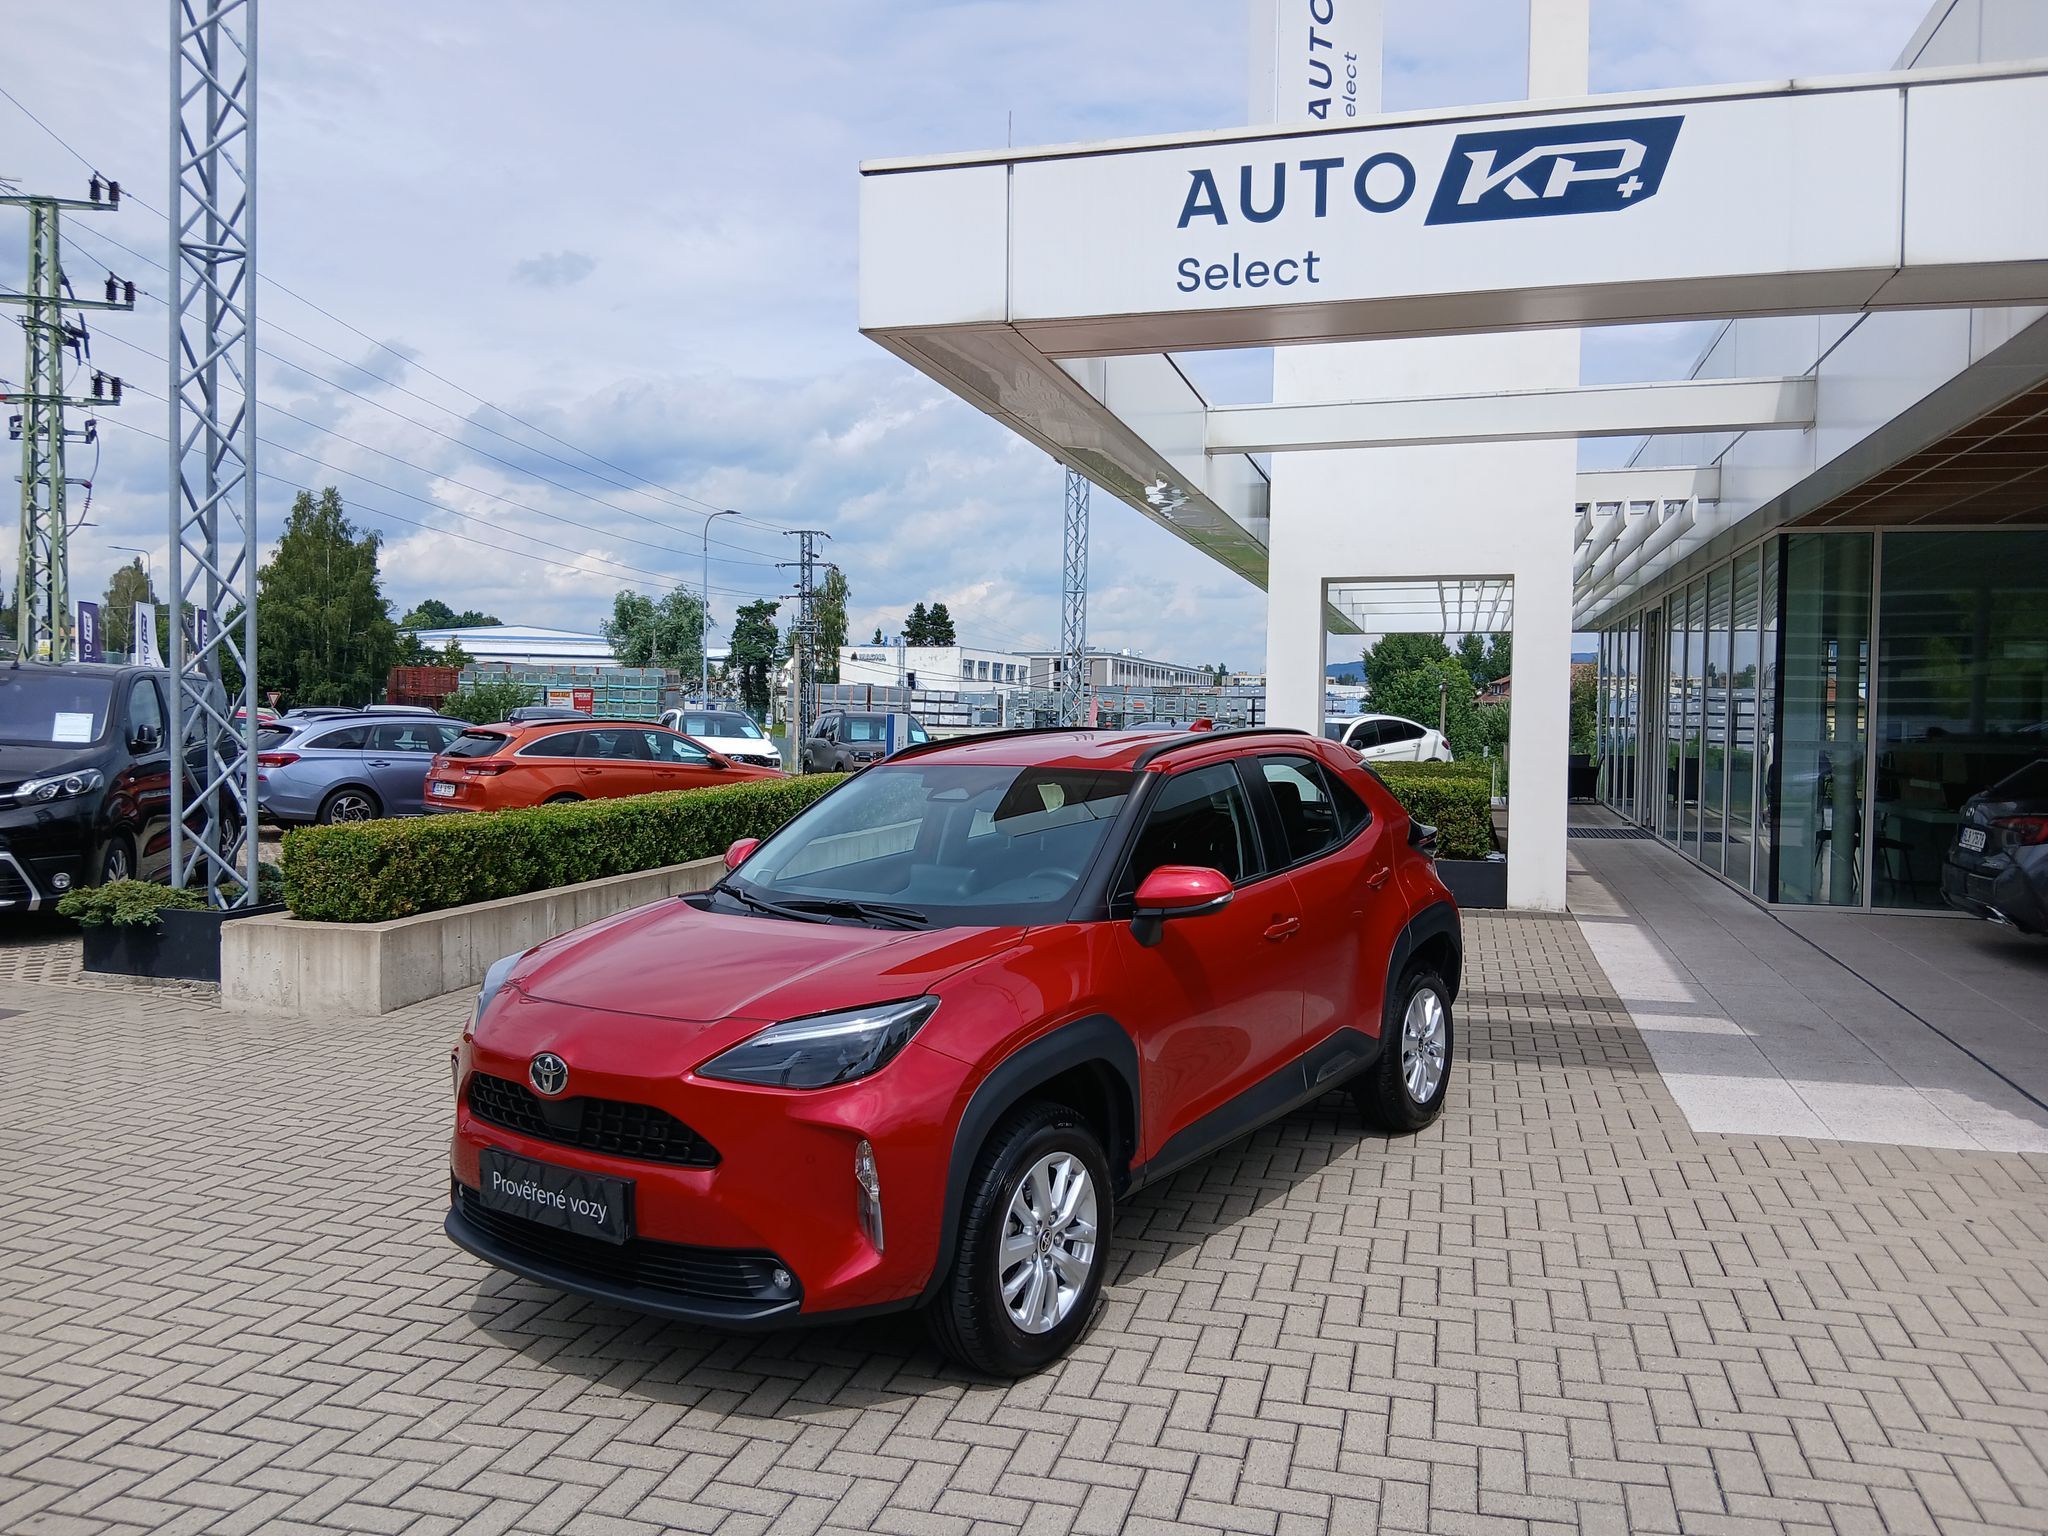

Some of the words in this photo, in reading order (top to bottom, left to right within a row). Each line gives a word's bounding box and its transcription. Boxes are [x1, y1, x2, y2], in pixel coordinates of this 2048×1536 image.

[1177, 152, 1416, 228] AUTO
[1177, 251, 1320, 292] Select
[493, 1171, 566, 1209] Prověřené
[570, 1197, 607, 1224] vozy
